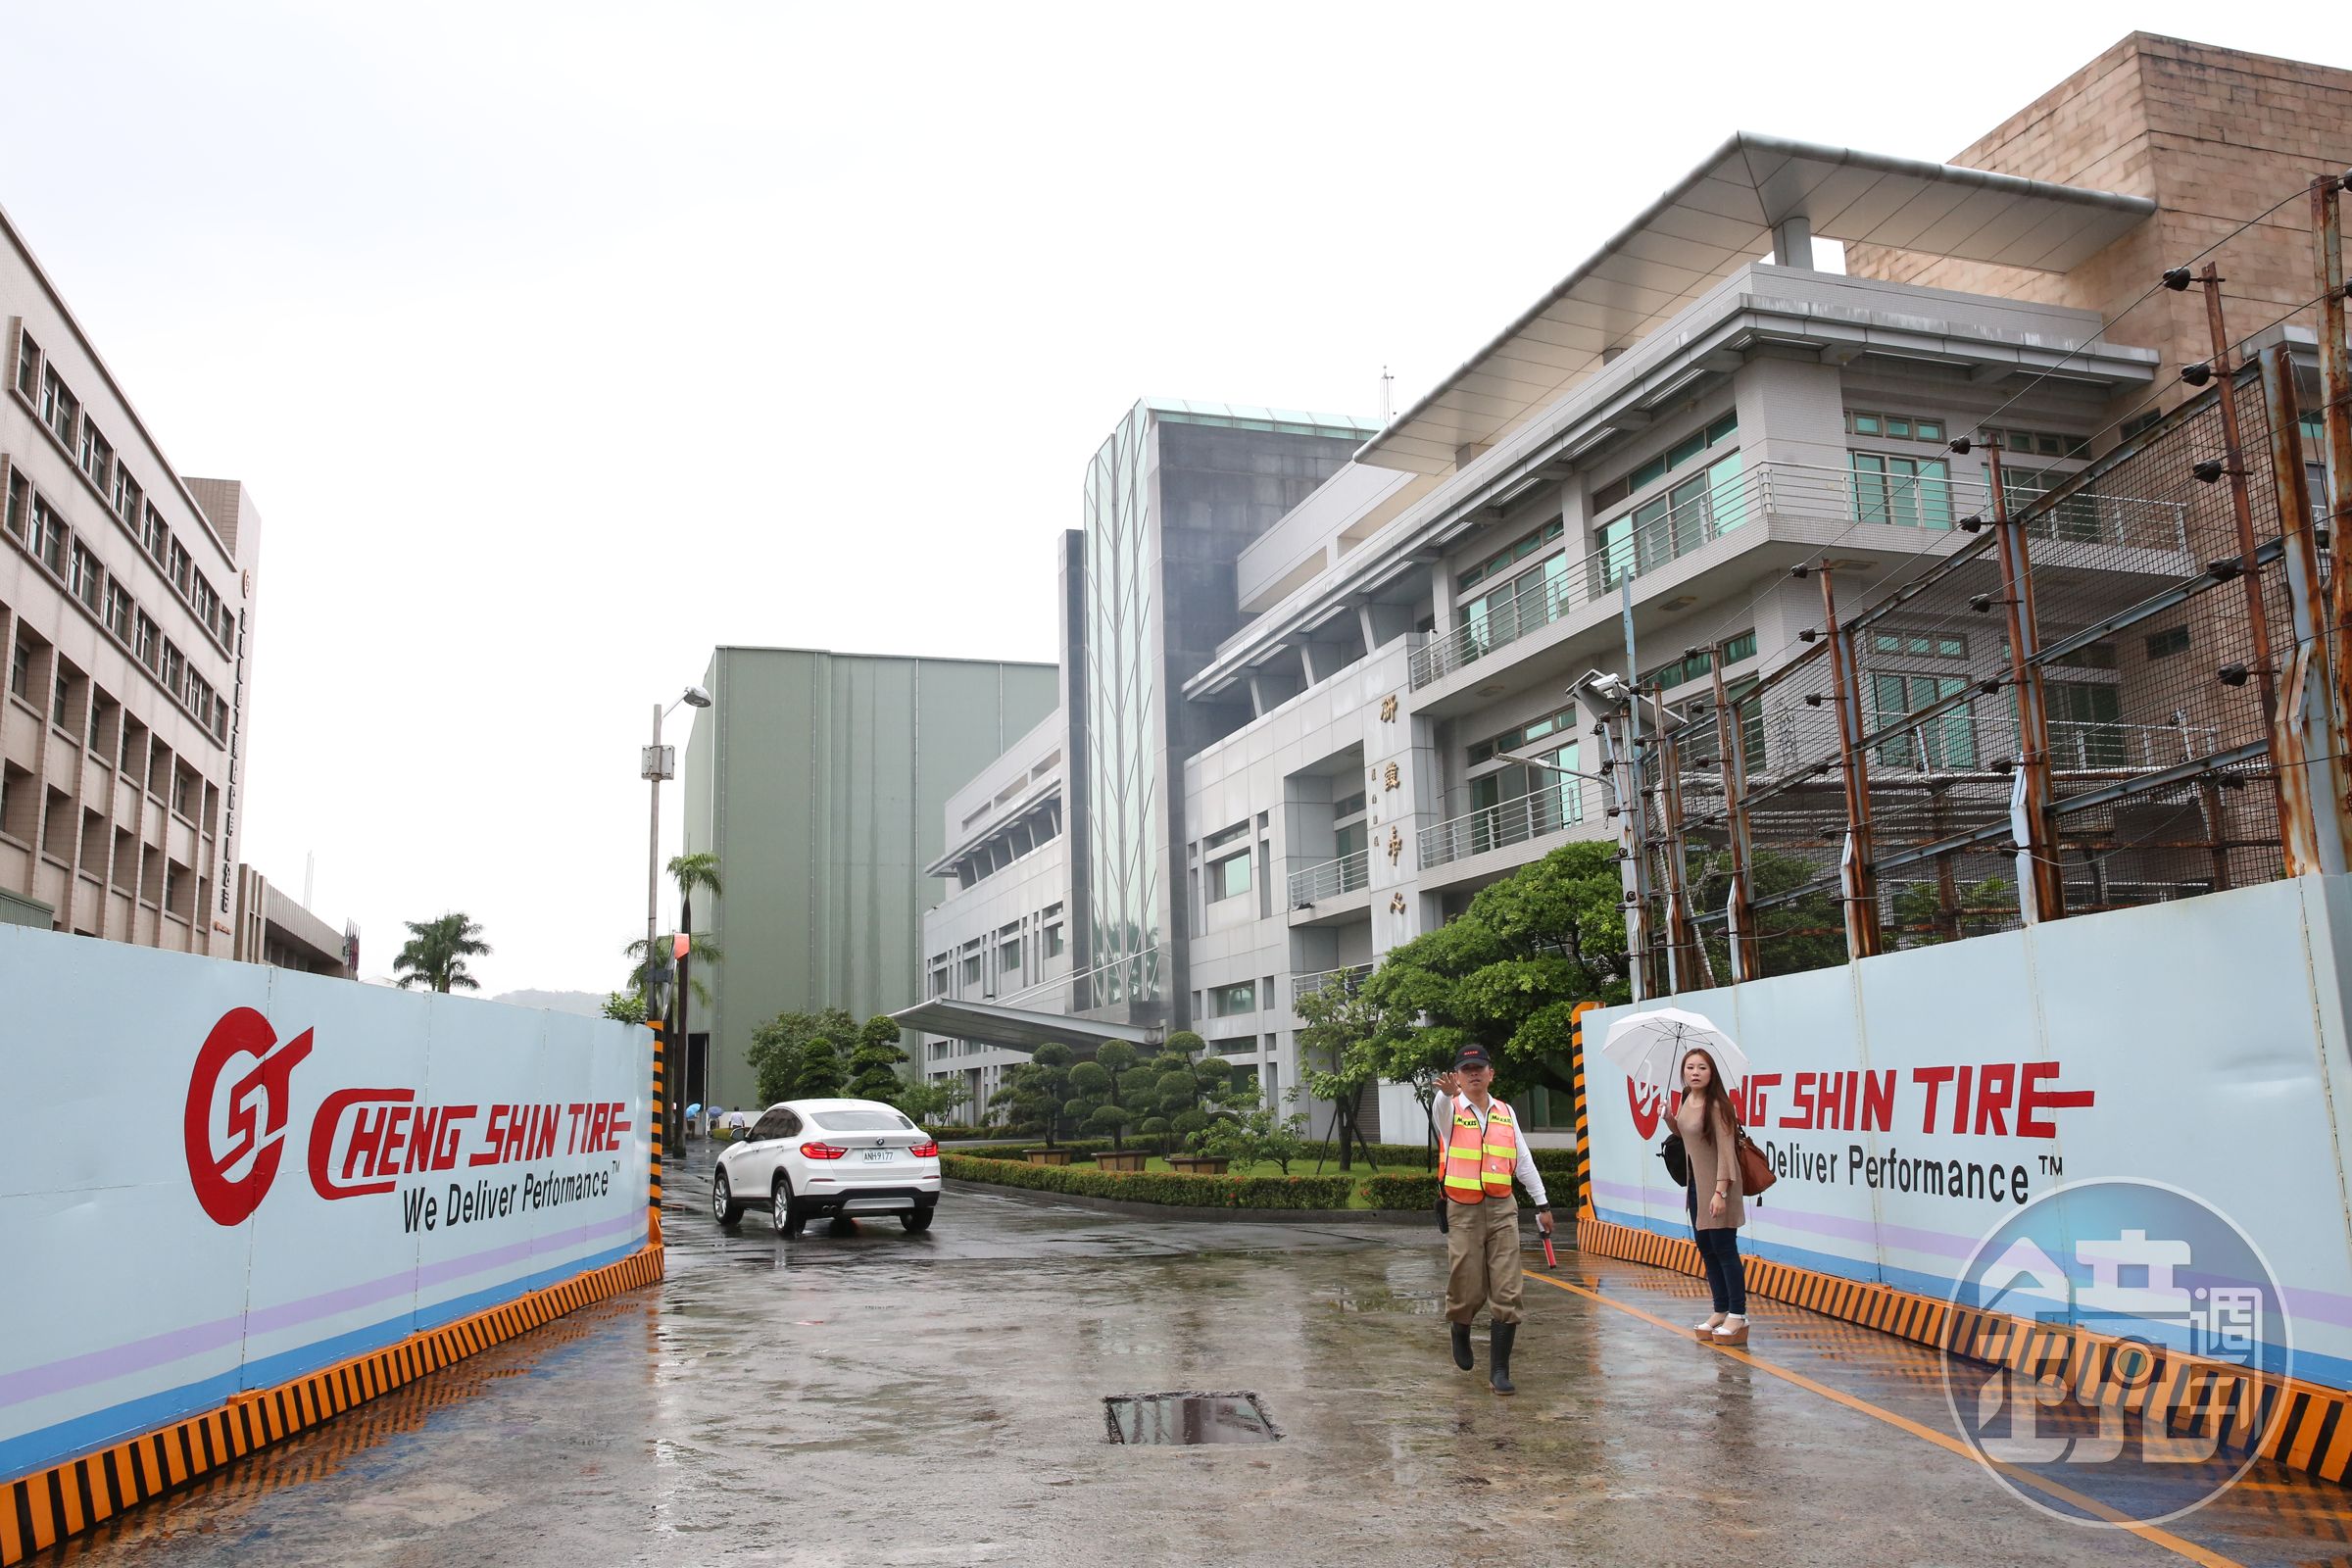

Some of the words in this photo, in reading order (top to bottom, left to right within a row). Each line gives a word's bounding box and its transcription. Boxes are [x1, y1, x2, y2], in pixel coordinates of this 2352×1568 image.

[1779, 1069, 1897, 1132] SHIN
[1913, 1061, 2094, 1138] TIRE
[308, 1088, 477, 1200] CHENG
[469, 1104, 561, 1166] SHIN
[568, 1102, 631, 1152] TIRE
[1765, 1141, 1838, 1184] Deliver
[1848, 1145, 2029, 1204] Performance
[403, 1186, 438, 1234] We
[446, 1178, 518, 1227] Deliver
[521, 1169, 609, 1212] Performance
